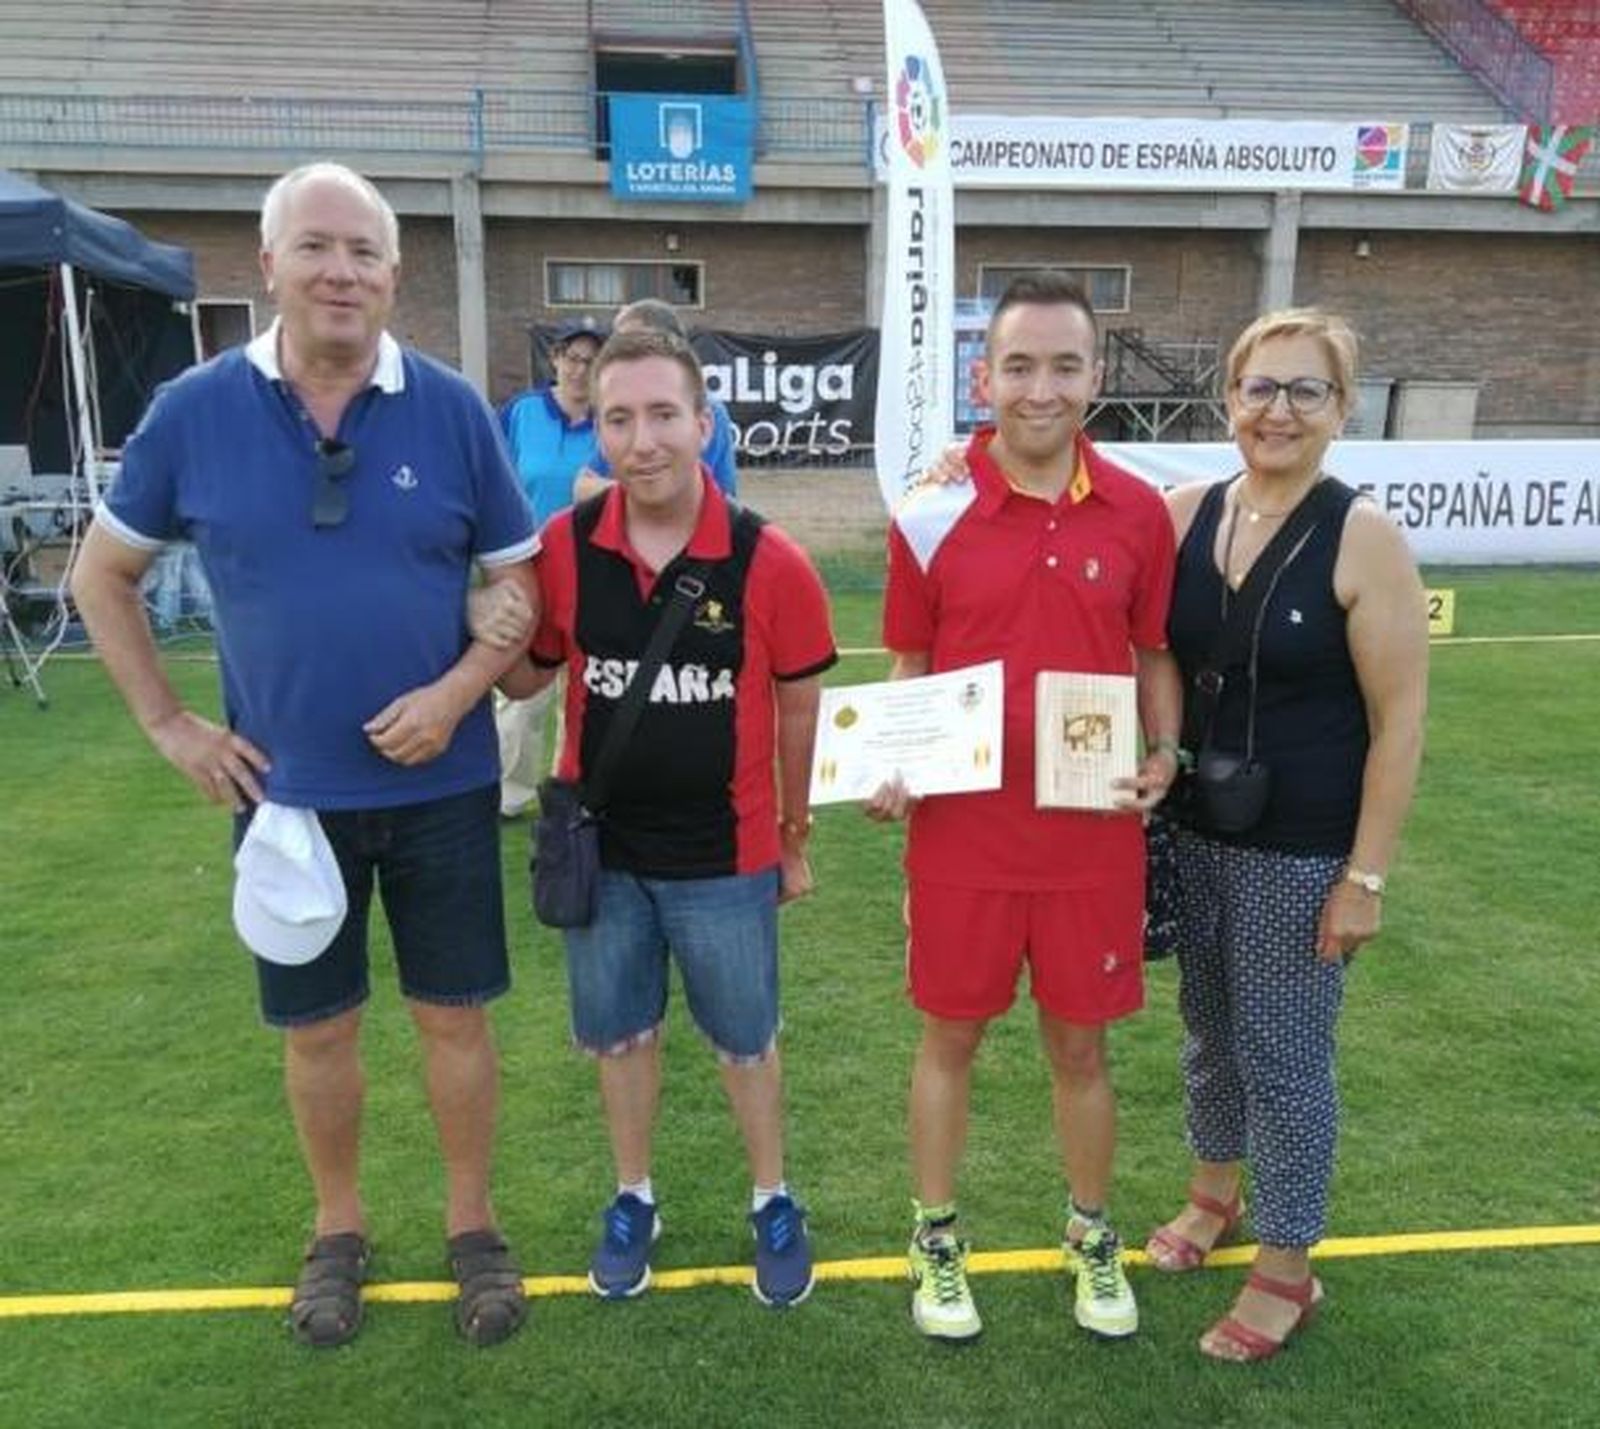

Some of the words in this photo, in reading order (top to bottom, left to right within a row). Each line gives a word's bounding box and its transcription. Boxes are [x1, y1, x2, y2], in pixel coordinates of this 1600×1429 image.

[627, 159, 736, 182] LOTERÍAS
[950, 140, 1094, 168] CAMPEONATO
[1102, 143, 1131, 169] DE
[1136, 138, 1218, 169] ESPAÑA
[1224, 145, 1336, 172] ABSOLUTO
[701, 351, 854, 413] aLiga
[1386, 471, 1514, 528] ESPAÑA
[1524, 481, 1567, 526] DE
[1573, 480, 1600, 525] A
